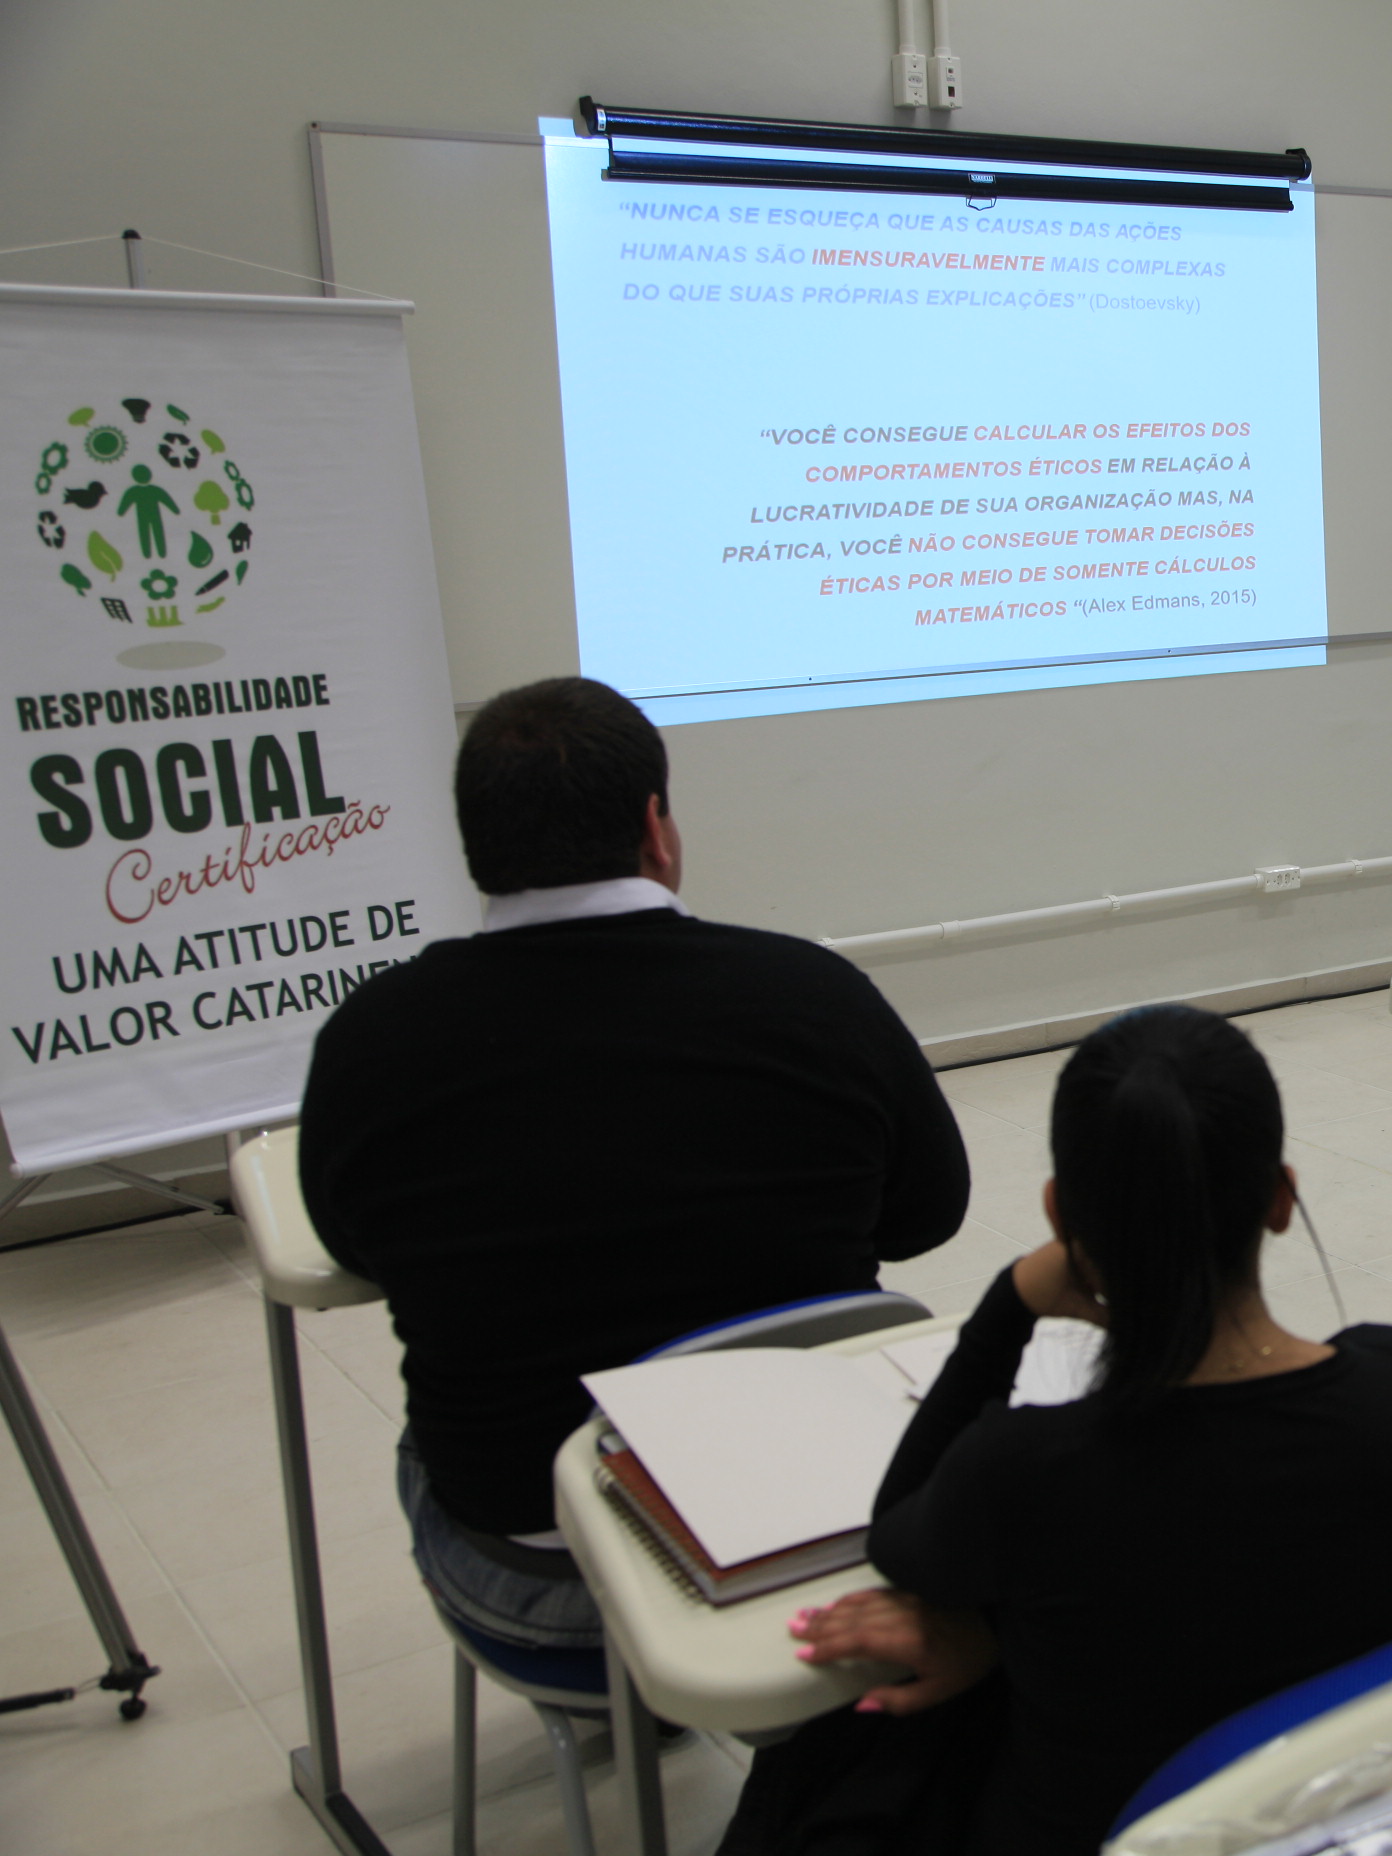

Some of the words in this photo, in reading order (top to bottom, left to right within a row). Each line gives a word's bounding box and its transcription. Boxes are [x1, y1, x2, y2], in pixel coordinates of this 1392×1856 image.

[728, 206, 761, 225] SE
[767, 207, 880, 231] ESQUEÇA
[887, 212, 935, 231] QUE
[939, 215, 969, 233] AS
[975, 216, 1063, 237] CAUSAS
[1069, 220, 1111, 239] DAS
[1115, 221, 1183, 242] AÇÕES
[619, 242, 748, 264] HUMANAS
[755, 243, 806, 265] SÃO
[811, 248, 1046, 273] IMENSURAVELMENTE
[1050, 256, 1100, 274] MAIS
[1106, 258, 1226, 278] COMPLEXAS
[622, 282, 660, 301] DO
[668, 283, 722, 303] QUE
[728, 284, 795, 303] SUAS
[801, 283, 920, 305] PRÓPRIAS
[1089, 292, 1201, 316] (Dostoevsky)
[843, 425, 969, 444] CONSEGUE
[973, 423, 1088, 441] CALCULAR
[1091, 423, 1121, 440] OS
[1125, 422, 1207, 439] EFEITOS
[1211, 421, 1252, 438] DOS
[805, 460, 1023, 483] COMPORTAMENTOS
[1027, 456, 1103, 476] ÉTICOS
[1107, 457, 1136, 474] EM
[1141, 453, 1234, 474] RELAÇÃO
[1238, 451, 1251, 471] À
[750, 499, 935, 524] LUCRATIVIDADE
[940, 498, 971, 516] DE
[975, 496, 1019, 514] SUA
[1024, 488, 1173, 512] ORGANIZAÇÃO
[1177, 490, 1223, 508] MAS,
[1228, 489, 1254, 505] NA
[722, 539, 832, 564] PRÁTICA,
[840, 533, 903, 557] VOCÊ
[908, 532, 957, 554] NÃO
[962, 529, 1081, 551] CONSEGUE
[1084, 526, 1155, 545] TOMAR
[1159, 519, 1256, 541] DECISÕES
[819, 574, 901, 596] ÉTICAS
[907, 571, 954, 590] POR
[959, 568, 1013, 587] MEIO
[1018, 566, 1049, 583] DE
[1052, 560, 1150, 581] SOMENTE
[1154, 555, 1258, 576] CÁLCULOS
[914, 600, 1068, 626] MATEMÁTICOS
[1131, 594, 1205, 612] Edmans,
[1210, 588, 1257, 607] 2015)
[16, 674, 330, 731] RESPONSABILIDADE
[30, 731, 346, 849] SOCIAL
[105, 800, 391, 923] Certificação
[52, 942, 163, 994] UMA
[174, 910, 354, 975] ATITUDE
[367, 899, 420, 941] DE
[12, 1001, 180, 1064] VALOR
[192, 955, 419, 1031] CATARIN
